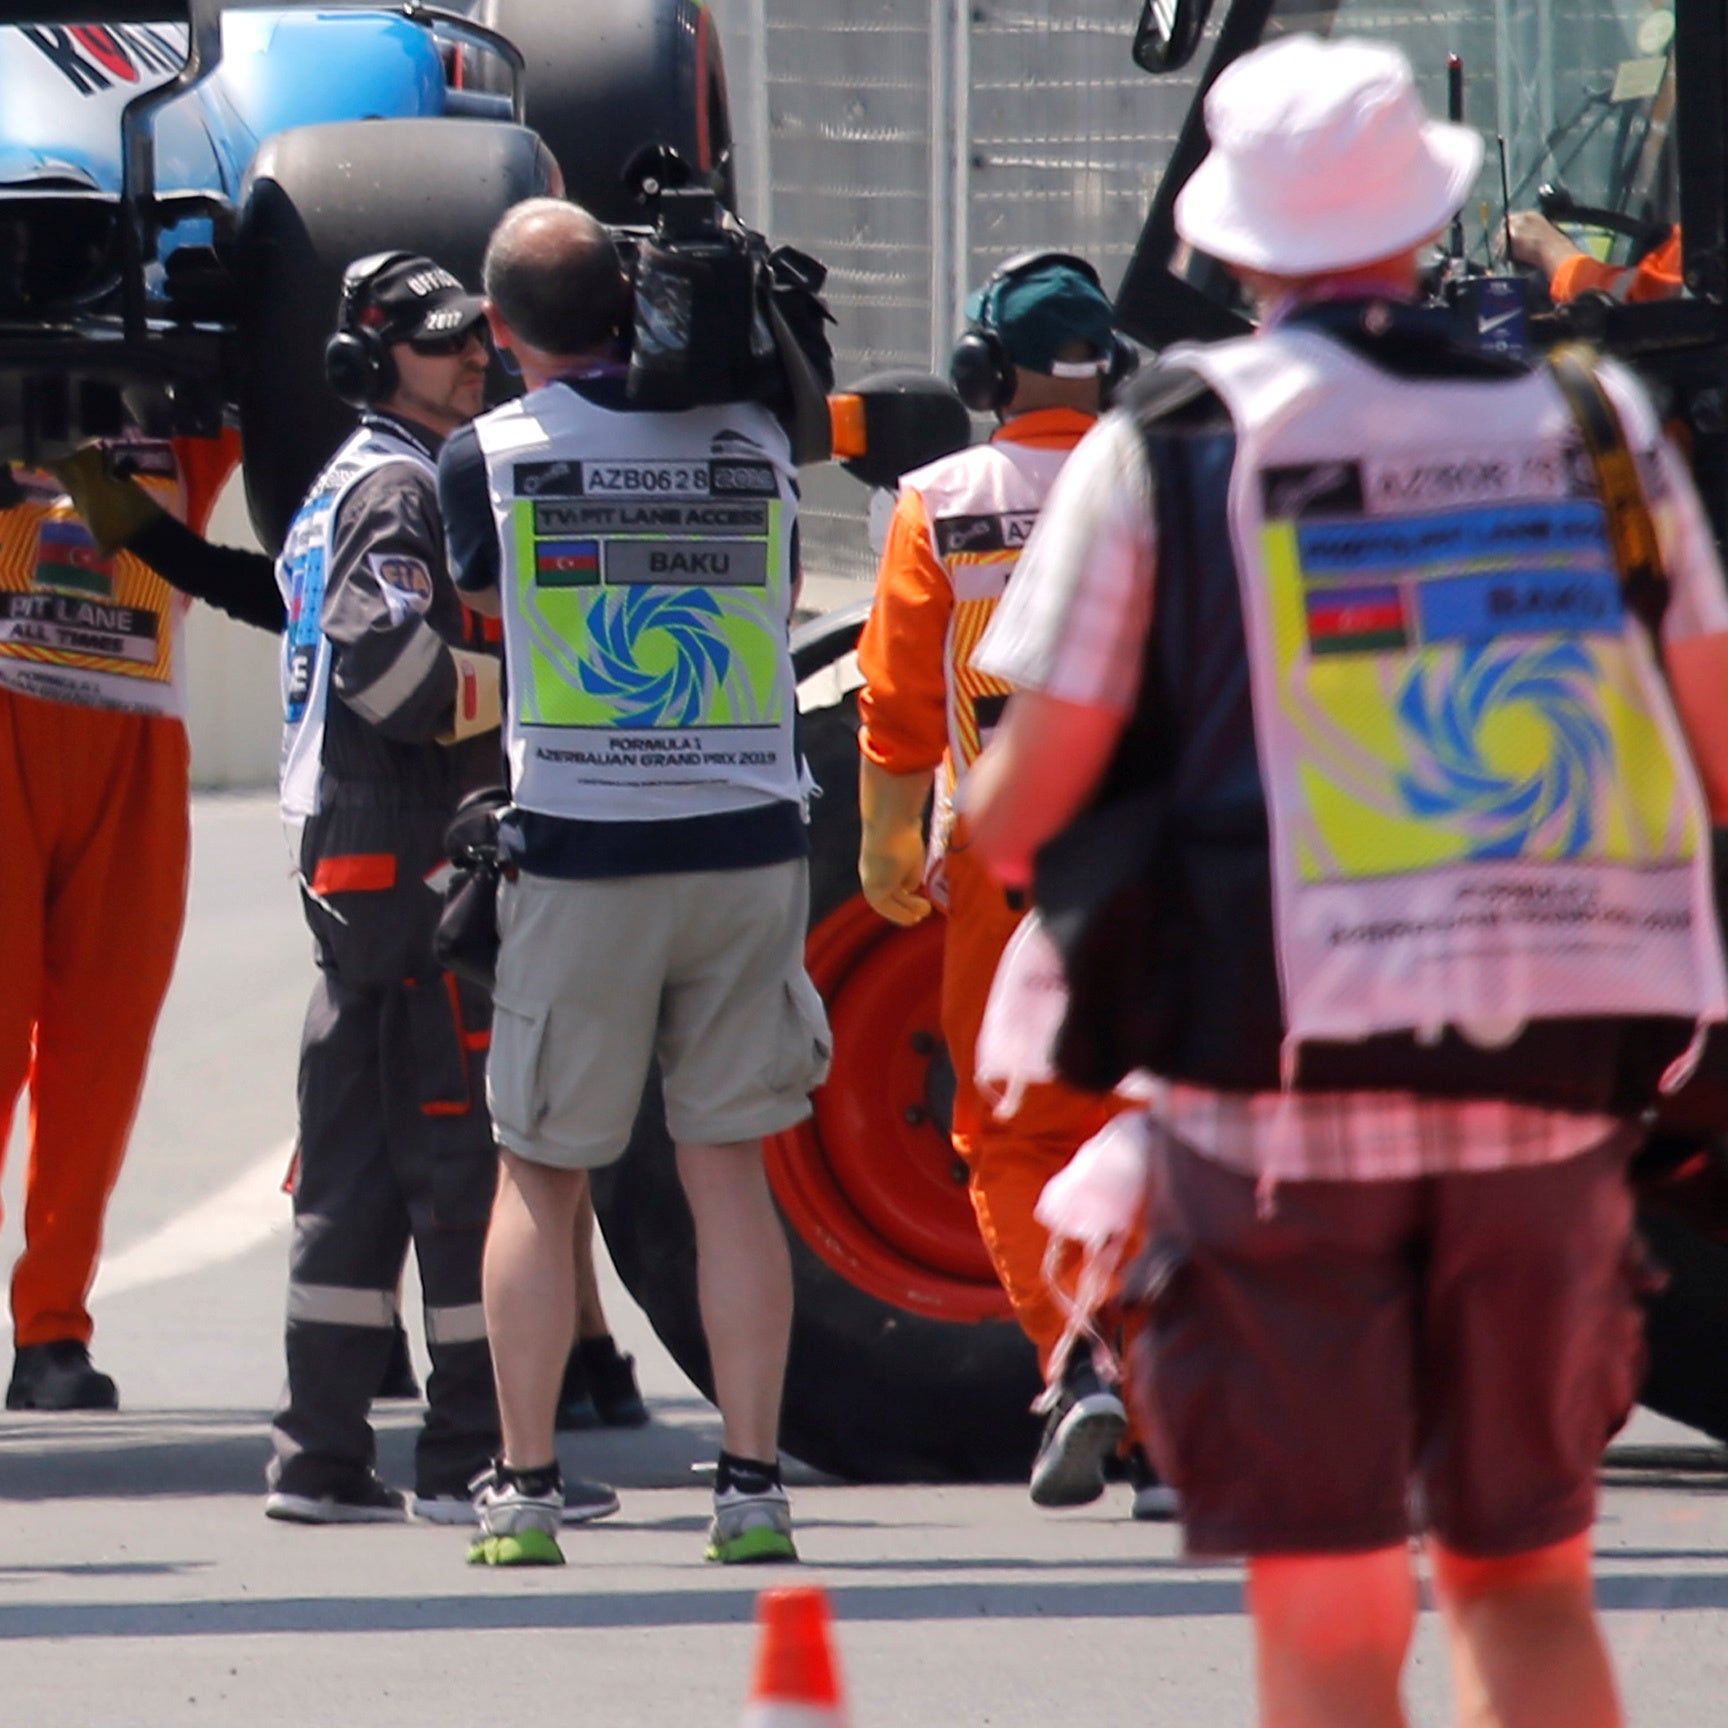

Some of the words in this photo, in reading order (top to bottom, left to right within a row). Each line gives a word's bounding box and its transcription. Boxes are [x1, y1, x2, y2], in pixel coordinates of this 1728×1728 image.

[588, 470, 708, 491] AZB0628
[649, 551, 730, 574] BAKU
[9, 594, 52, 620] PIT
[56, 599, 134, 633] LANE
[609, 736, 690, 752] FORMULA
[640, 750, 701, 767] GRAND
